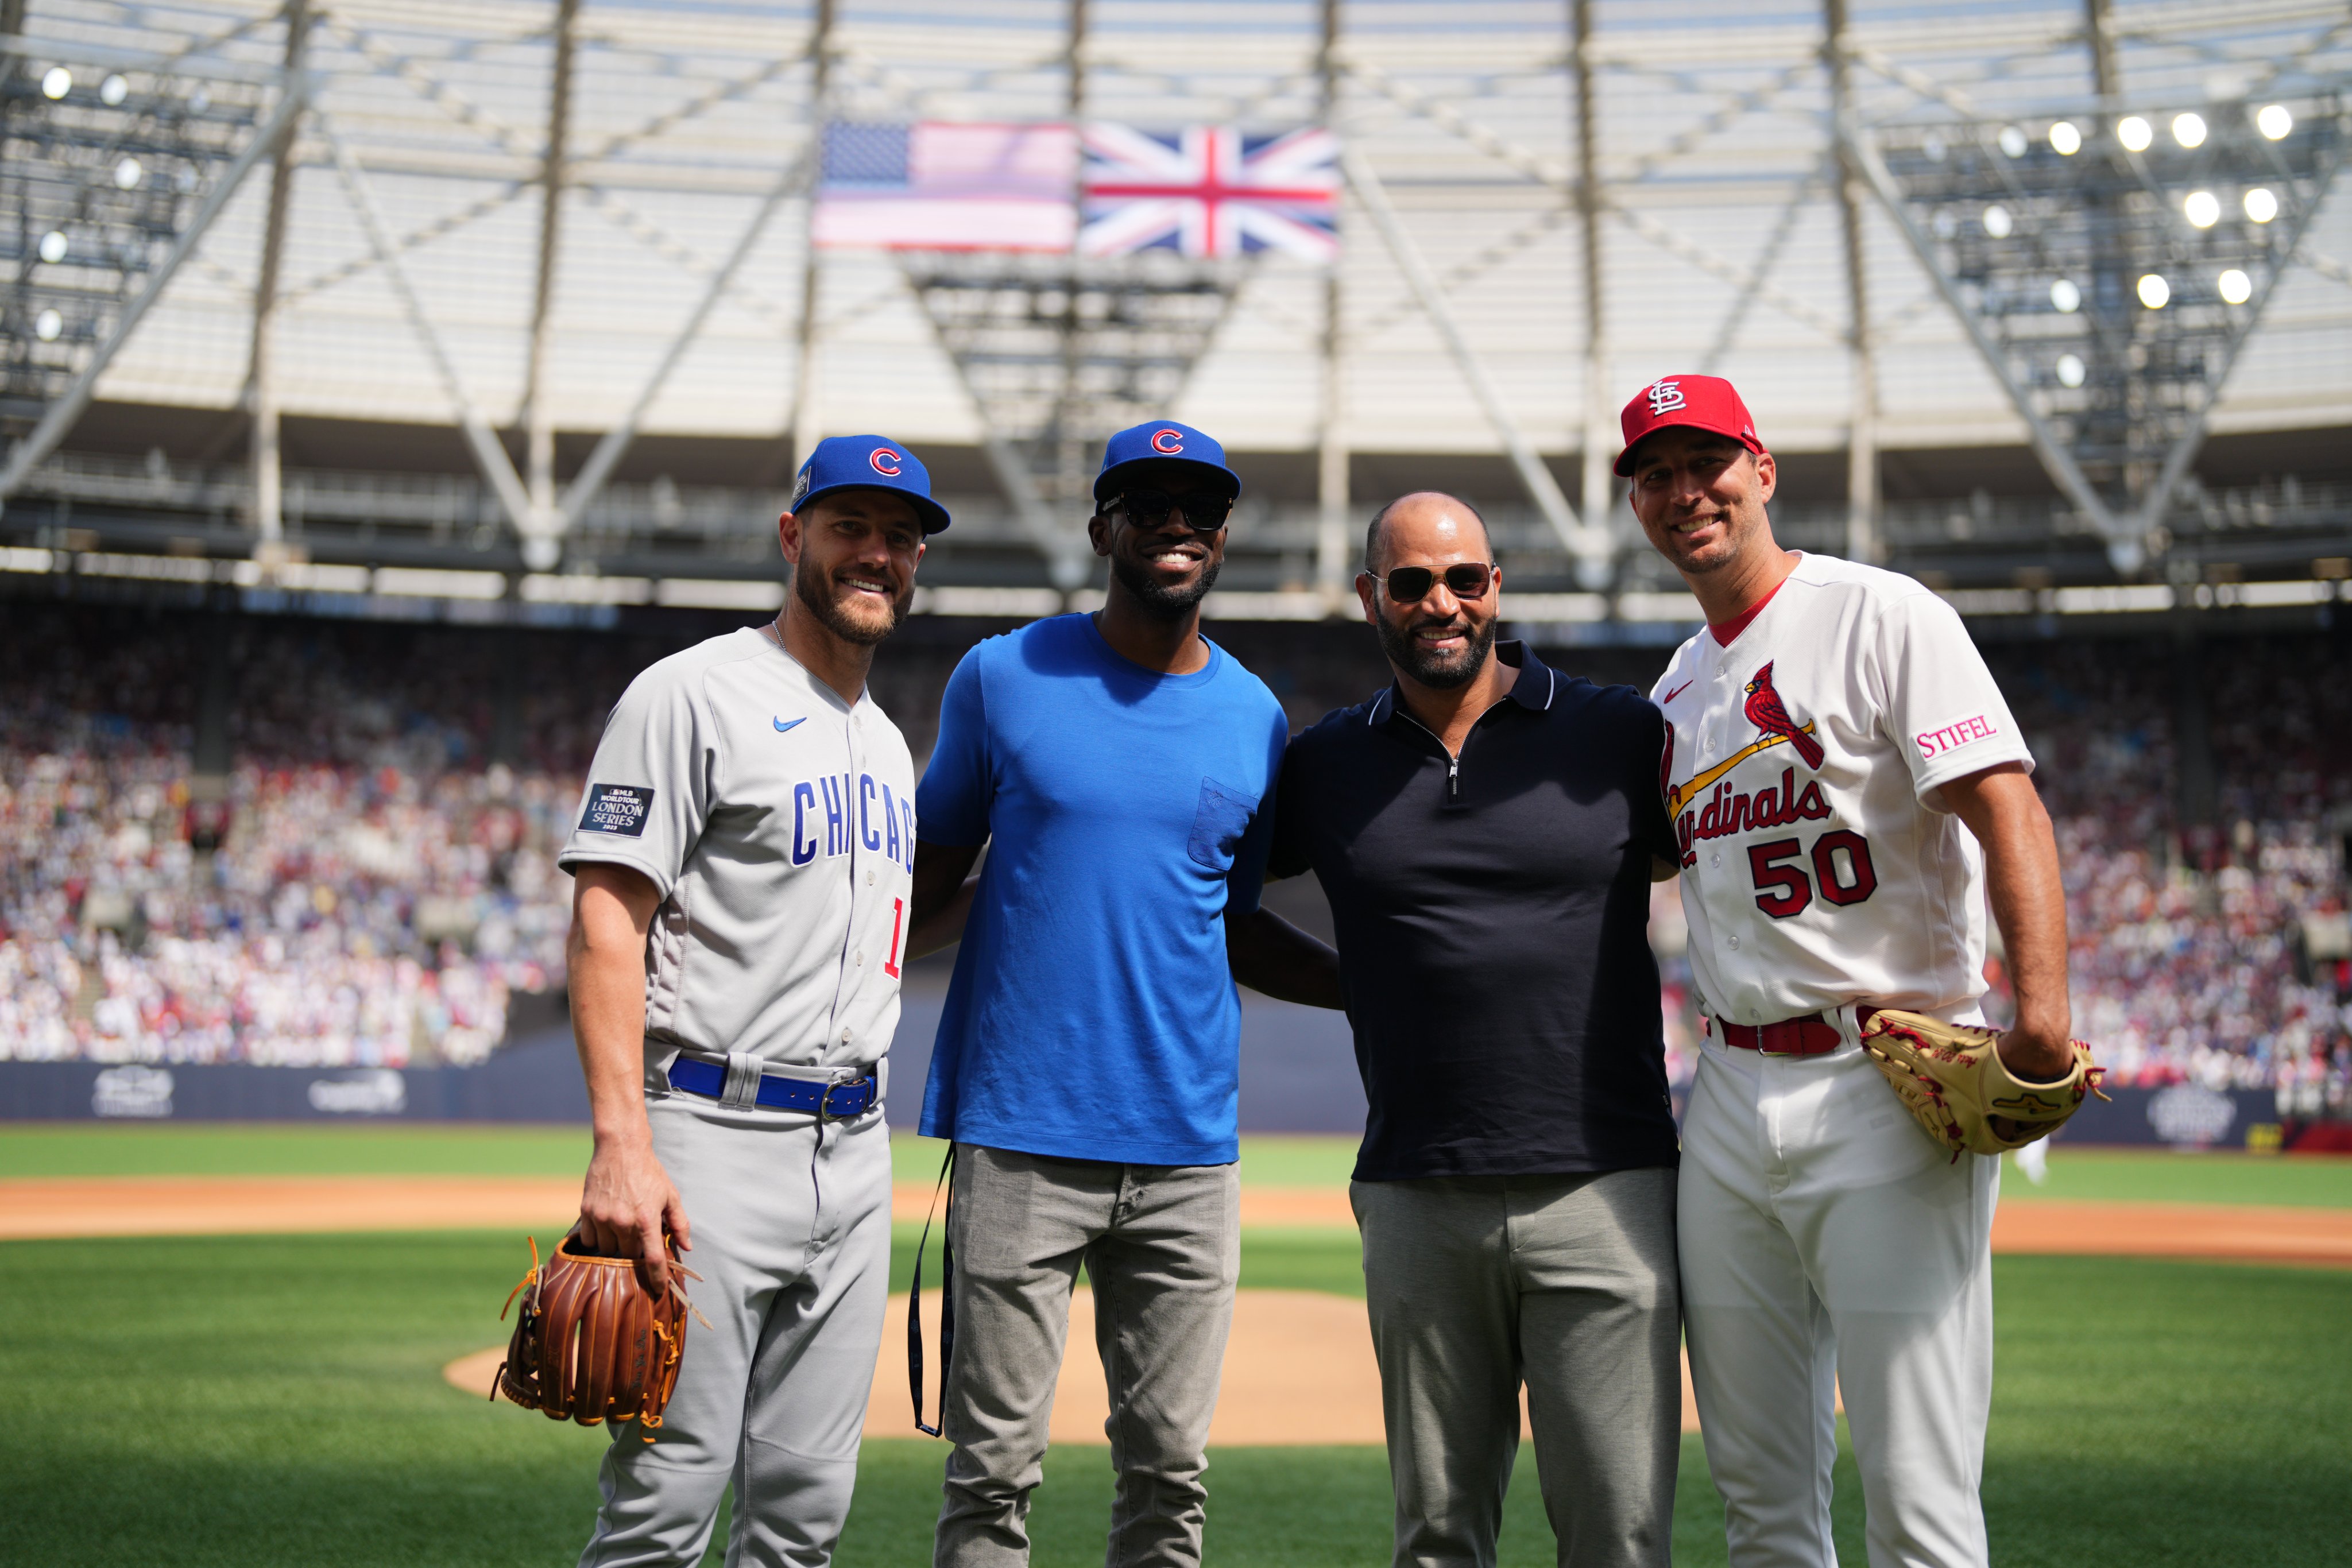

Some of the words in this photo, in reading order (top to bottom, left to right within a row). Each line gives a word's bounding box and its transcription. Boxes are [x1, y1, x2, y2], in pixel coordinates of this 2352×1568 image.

[1151, 428, 1183, 455] C
[869, 448, 902, 477] C
[1917, 715, 1997, 758] STIFEL
[591, 801, 644, 817] LONDON
[601, 795, 623, 803] WORLD
[592, 812, 635, 826] SERIES
[791, 771, 917, 877] CHICAG
[1747, 828, 1878, 919] 50
